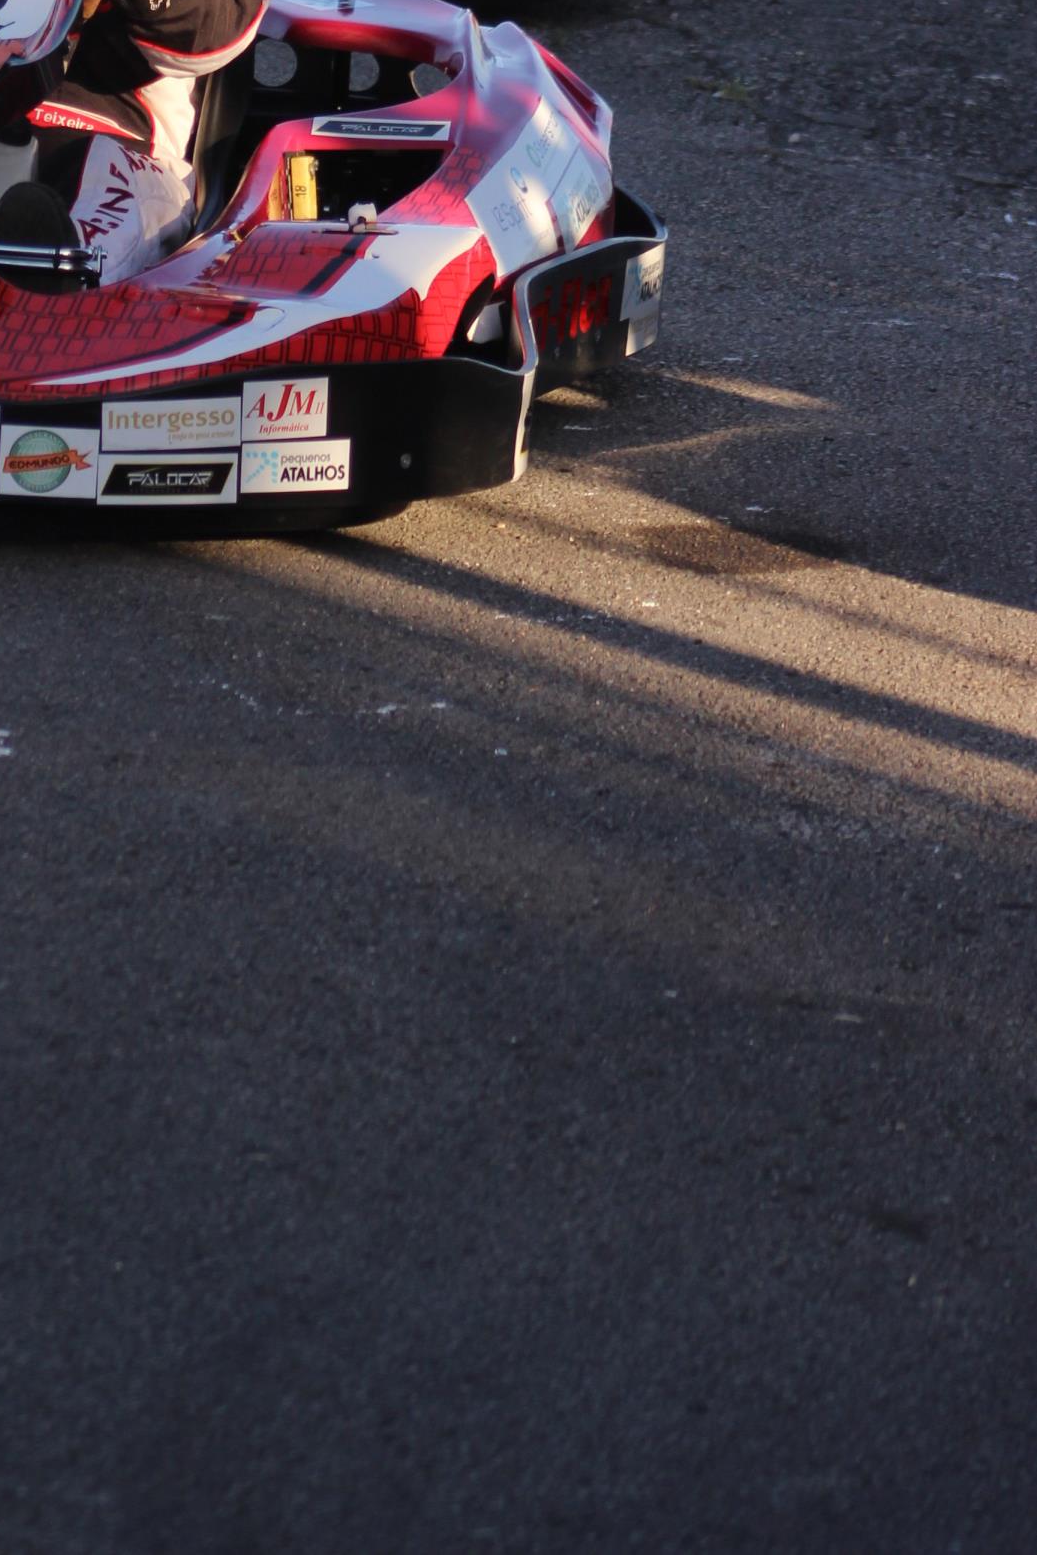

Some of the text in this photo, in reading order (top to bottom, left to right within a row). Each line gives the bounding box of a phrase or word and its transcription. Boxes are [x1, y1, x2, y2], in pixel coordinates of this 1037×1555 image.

[246, 383, 317, 423] AJM
[107, 407, 236, 433] Intergesso
[259, 422, 309, 436] Informática
[8, 453, 71, 470] EDMUNDO
[280, 452, 332, 466] pequenos
[127, 470, 214, 488] PALOCAR
[279, 465, 346, 484] ATALHOS
